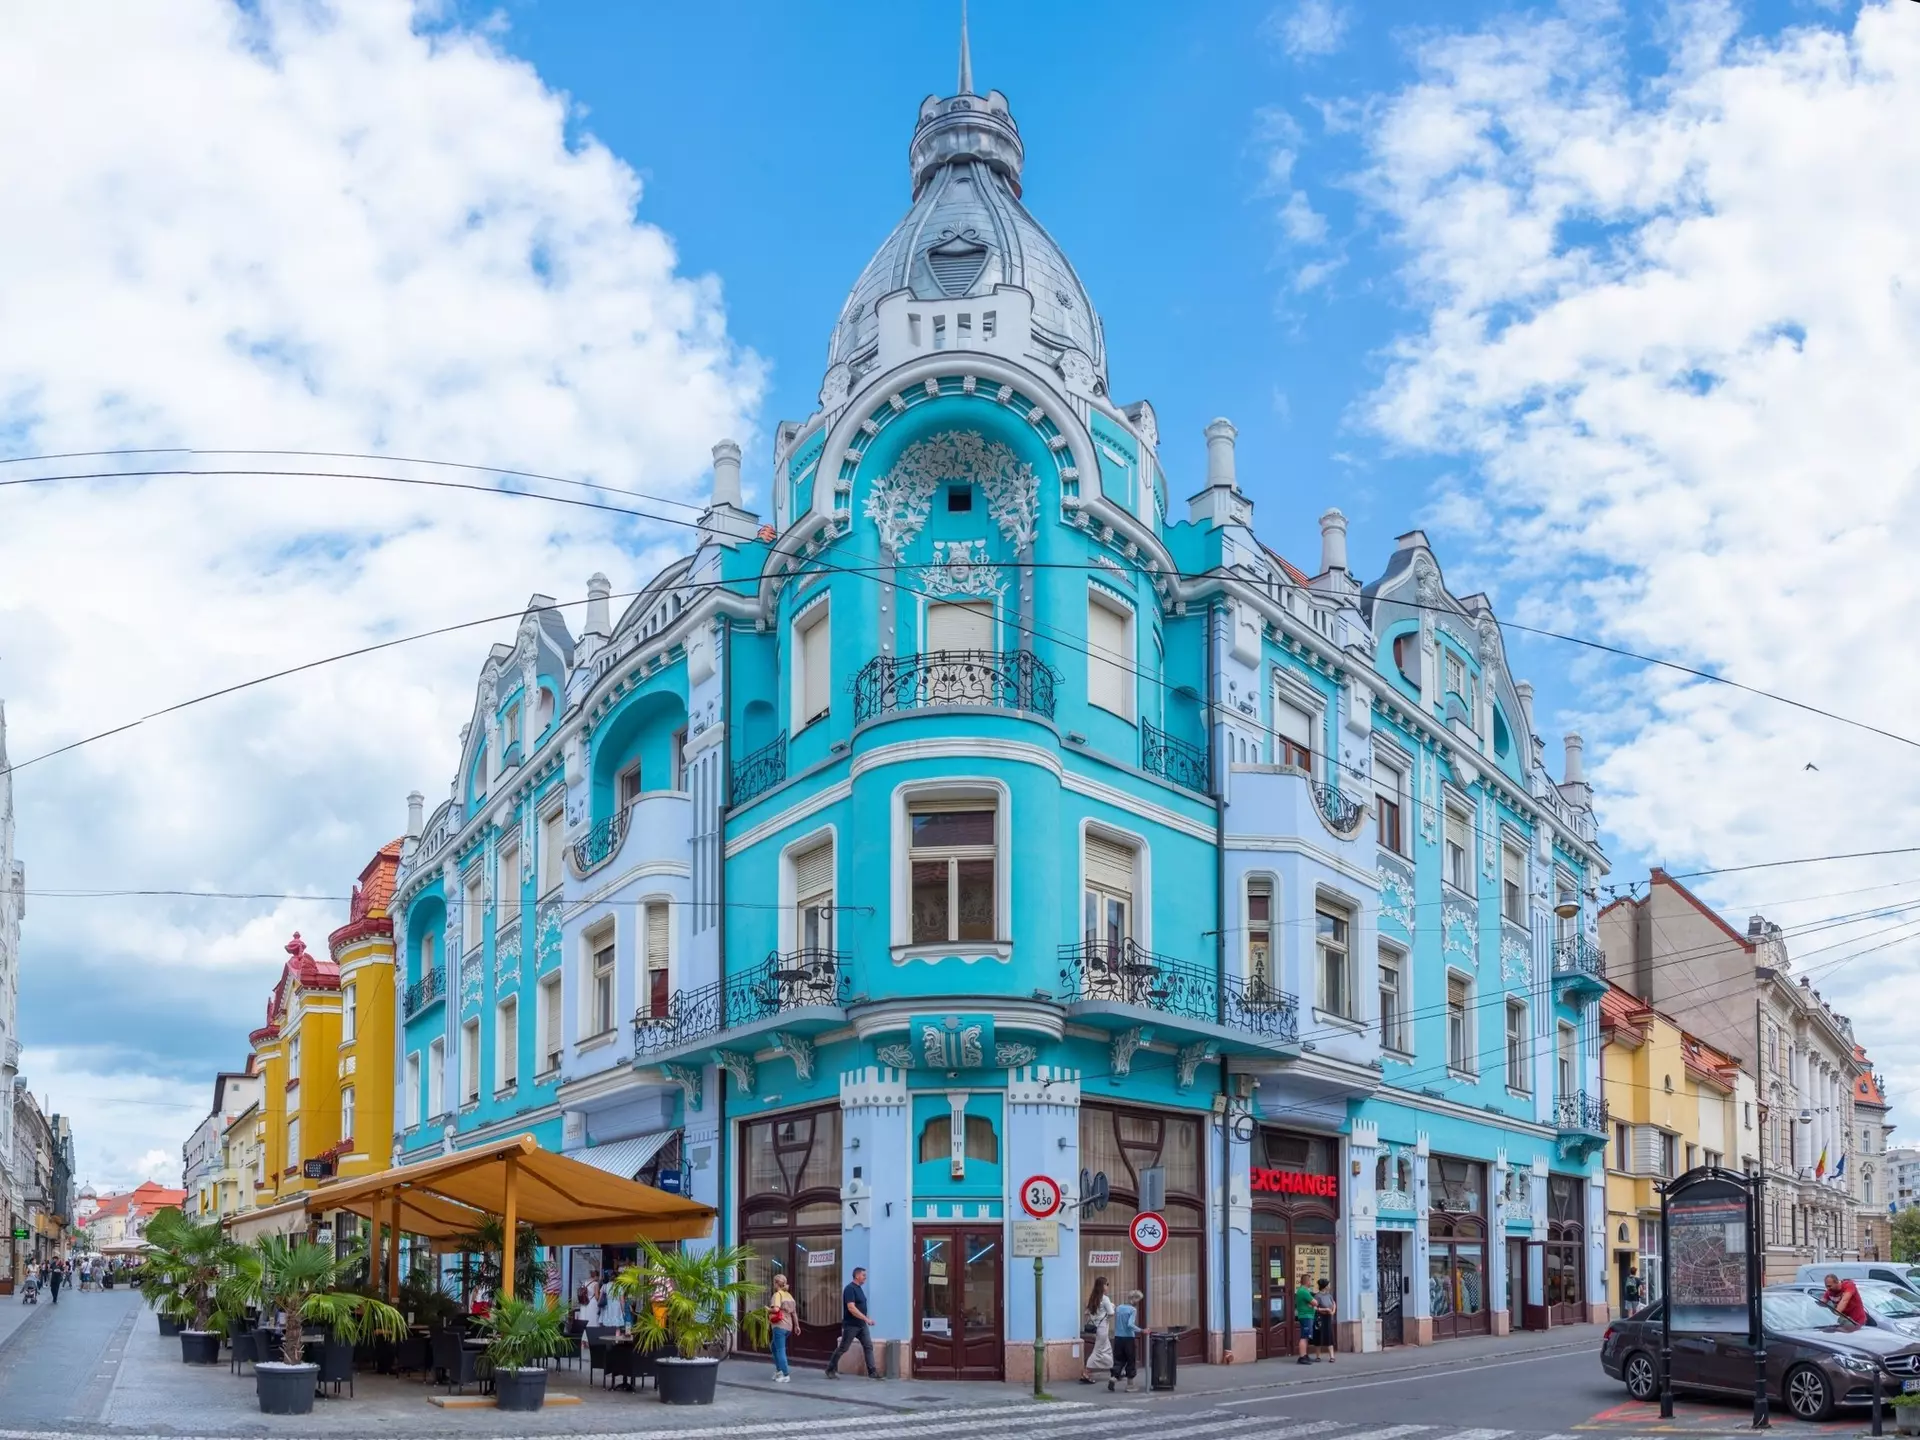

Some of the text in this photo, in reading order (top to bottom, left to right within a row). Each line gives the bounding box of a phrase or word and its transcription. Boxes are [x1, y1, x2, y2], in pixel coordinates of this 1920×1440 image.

[1249, 1167, 1337, 1197] EXCHANGE
[1298, 1247, 1328, 1256] EXCHANGE
[810, 1253, 833, 1263] FRIZERIE
[1091, 1253, 1119, 1264] FRIZERIE
